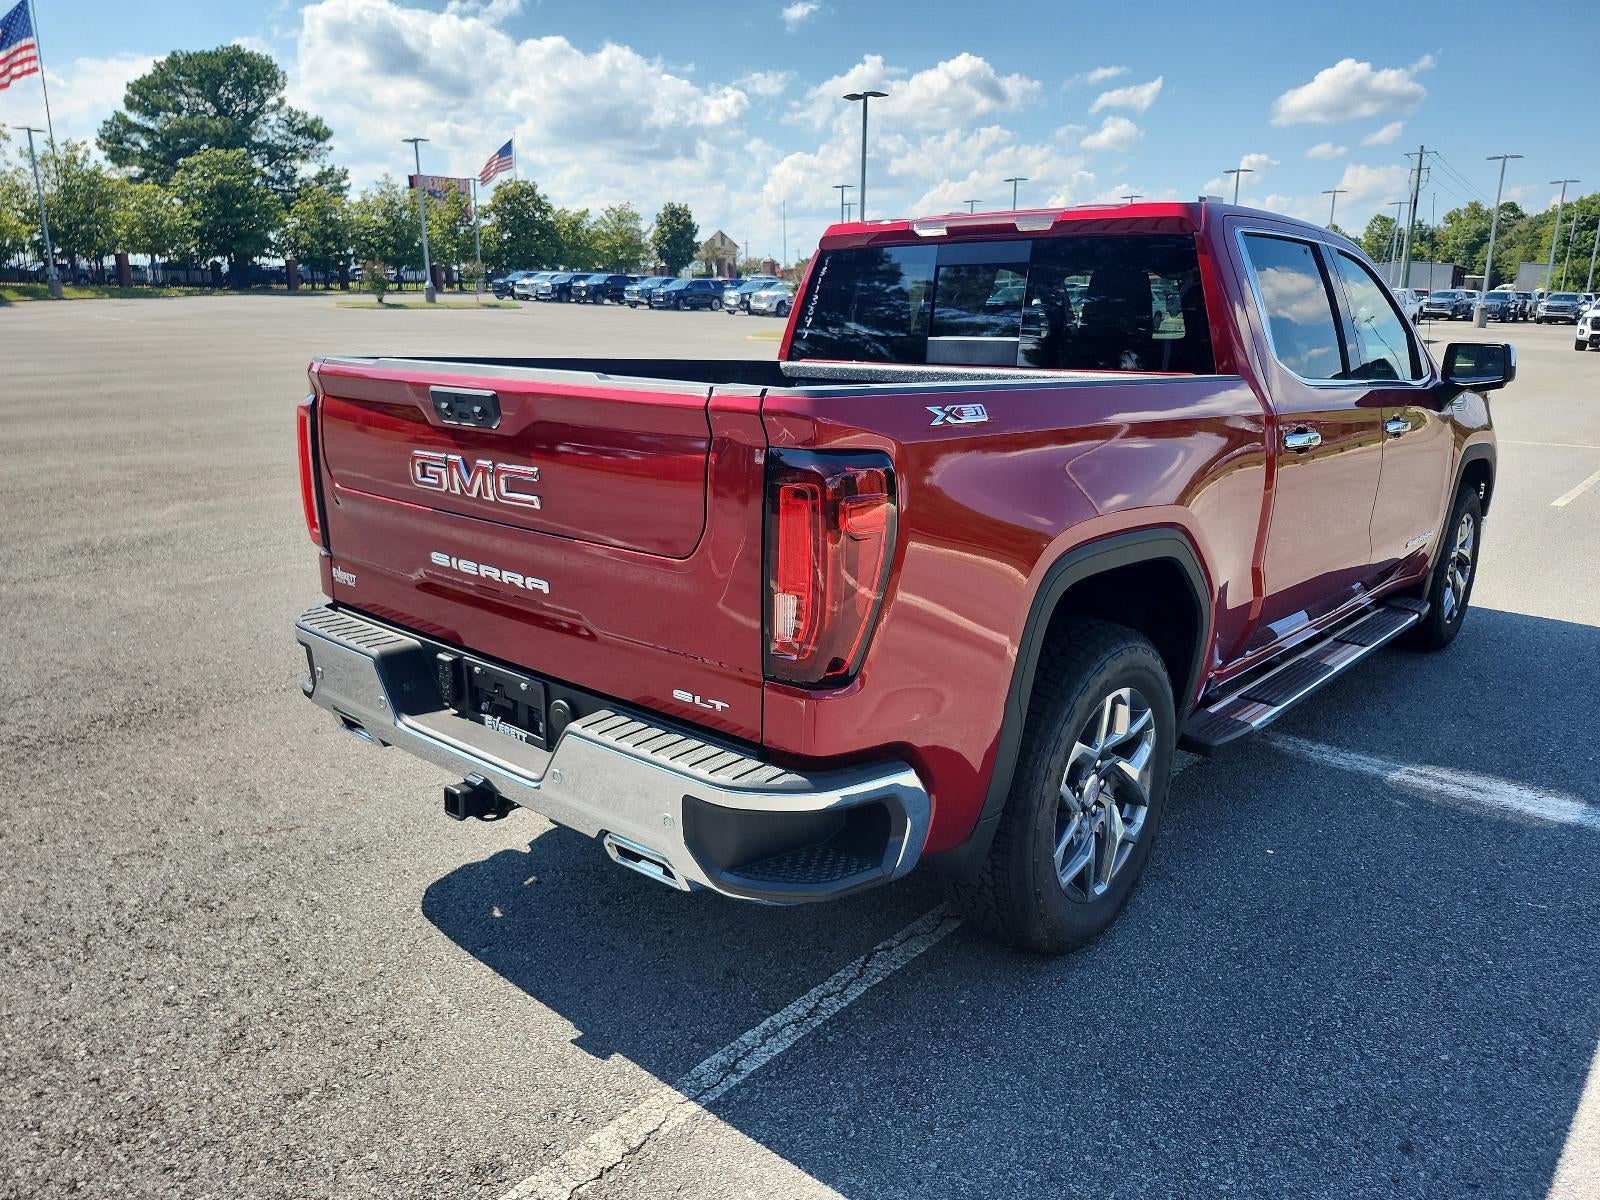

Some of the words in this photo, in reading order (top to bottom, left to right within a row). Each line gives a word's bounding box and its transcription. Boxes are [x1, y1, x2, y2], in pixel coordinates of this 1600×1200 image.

[409, 449, 541, 510] GMC
[430, 551, 550, 594] SIERRA
[672, 689, 730, 712] SLT
[483, 713, 528, 743] EVERETT
